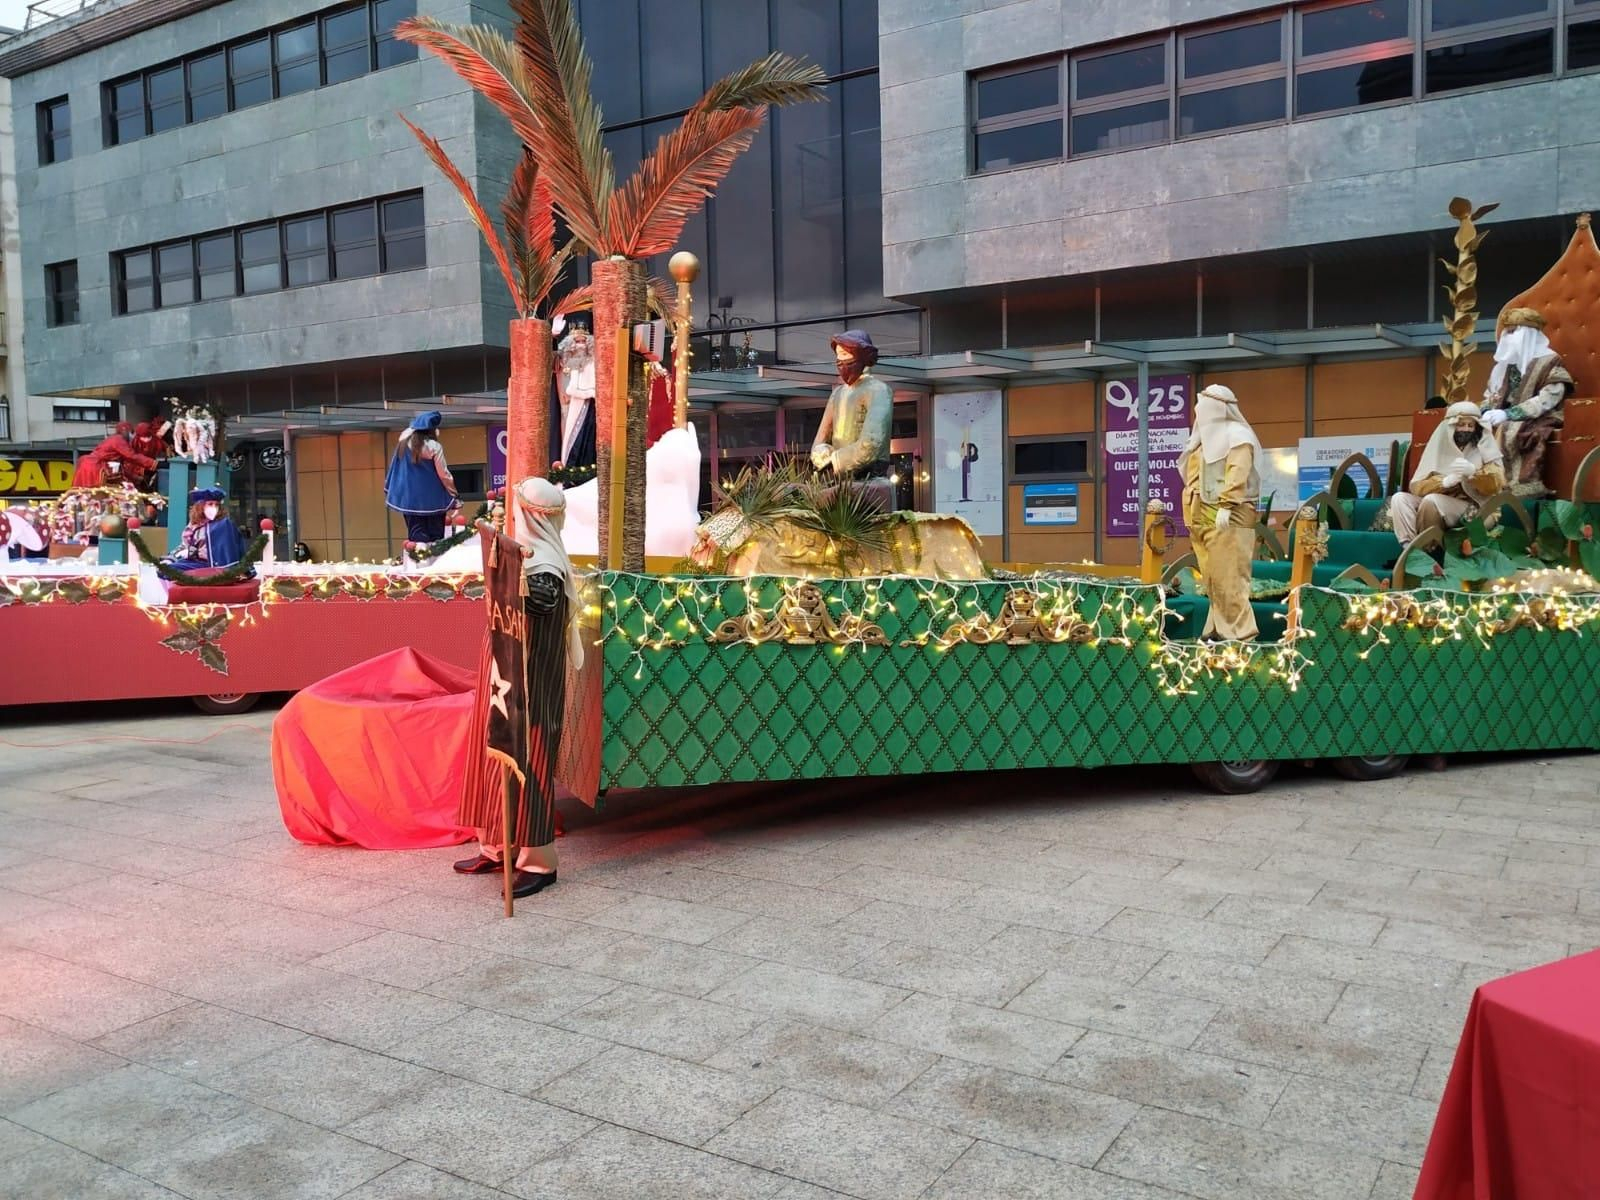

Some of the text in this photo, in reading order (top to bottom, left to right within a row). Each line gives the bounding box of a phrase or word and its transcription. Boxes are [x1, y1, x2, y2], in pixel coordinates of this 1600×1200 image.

[1148, 385, 1185, 413] 25
[1128, 429, 1179, 439] INTNACIONAL
[0, 459, 75, 492] GAD
[1131, 473, 1164, 485] VAS,
[1126, 487, 1170, 499] LIBES E
